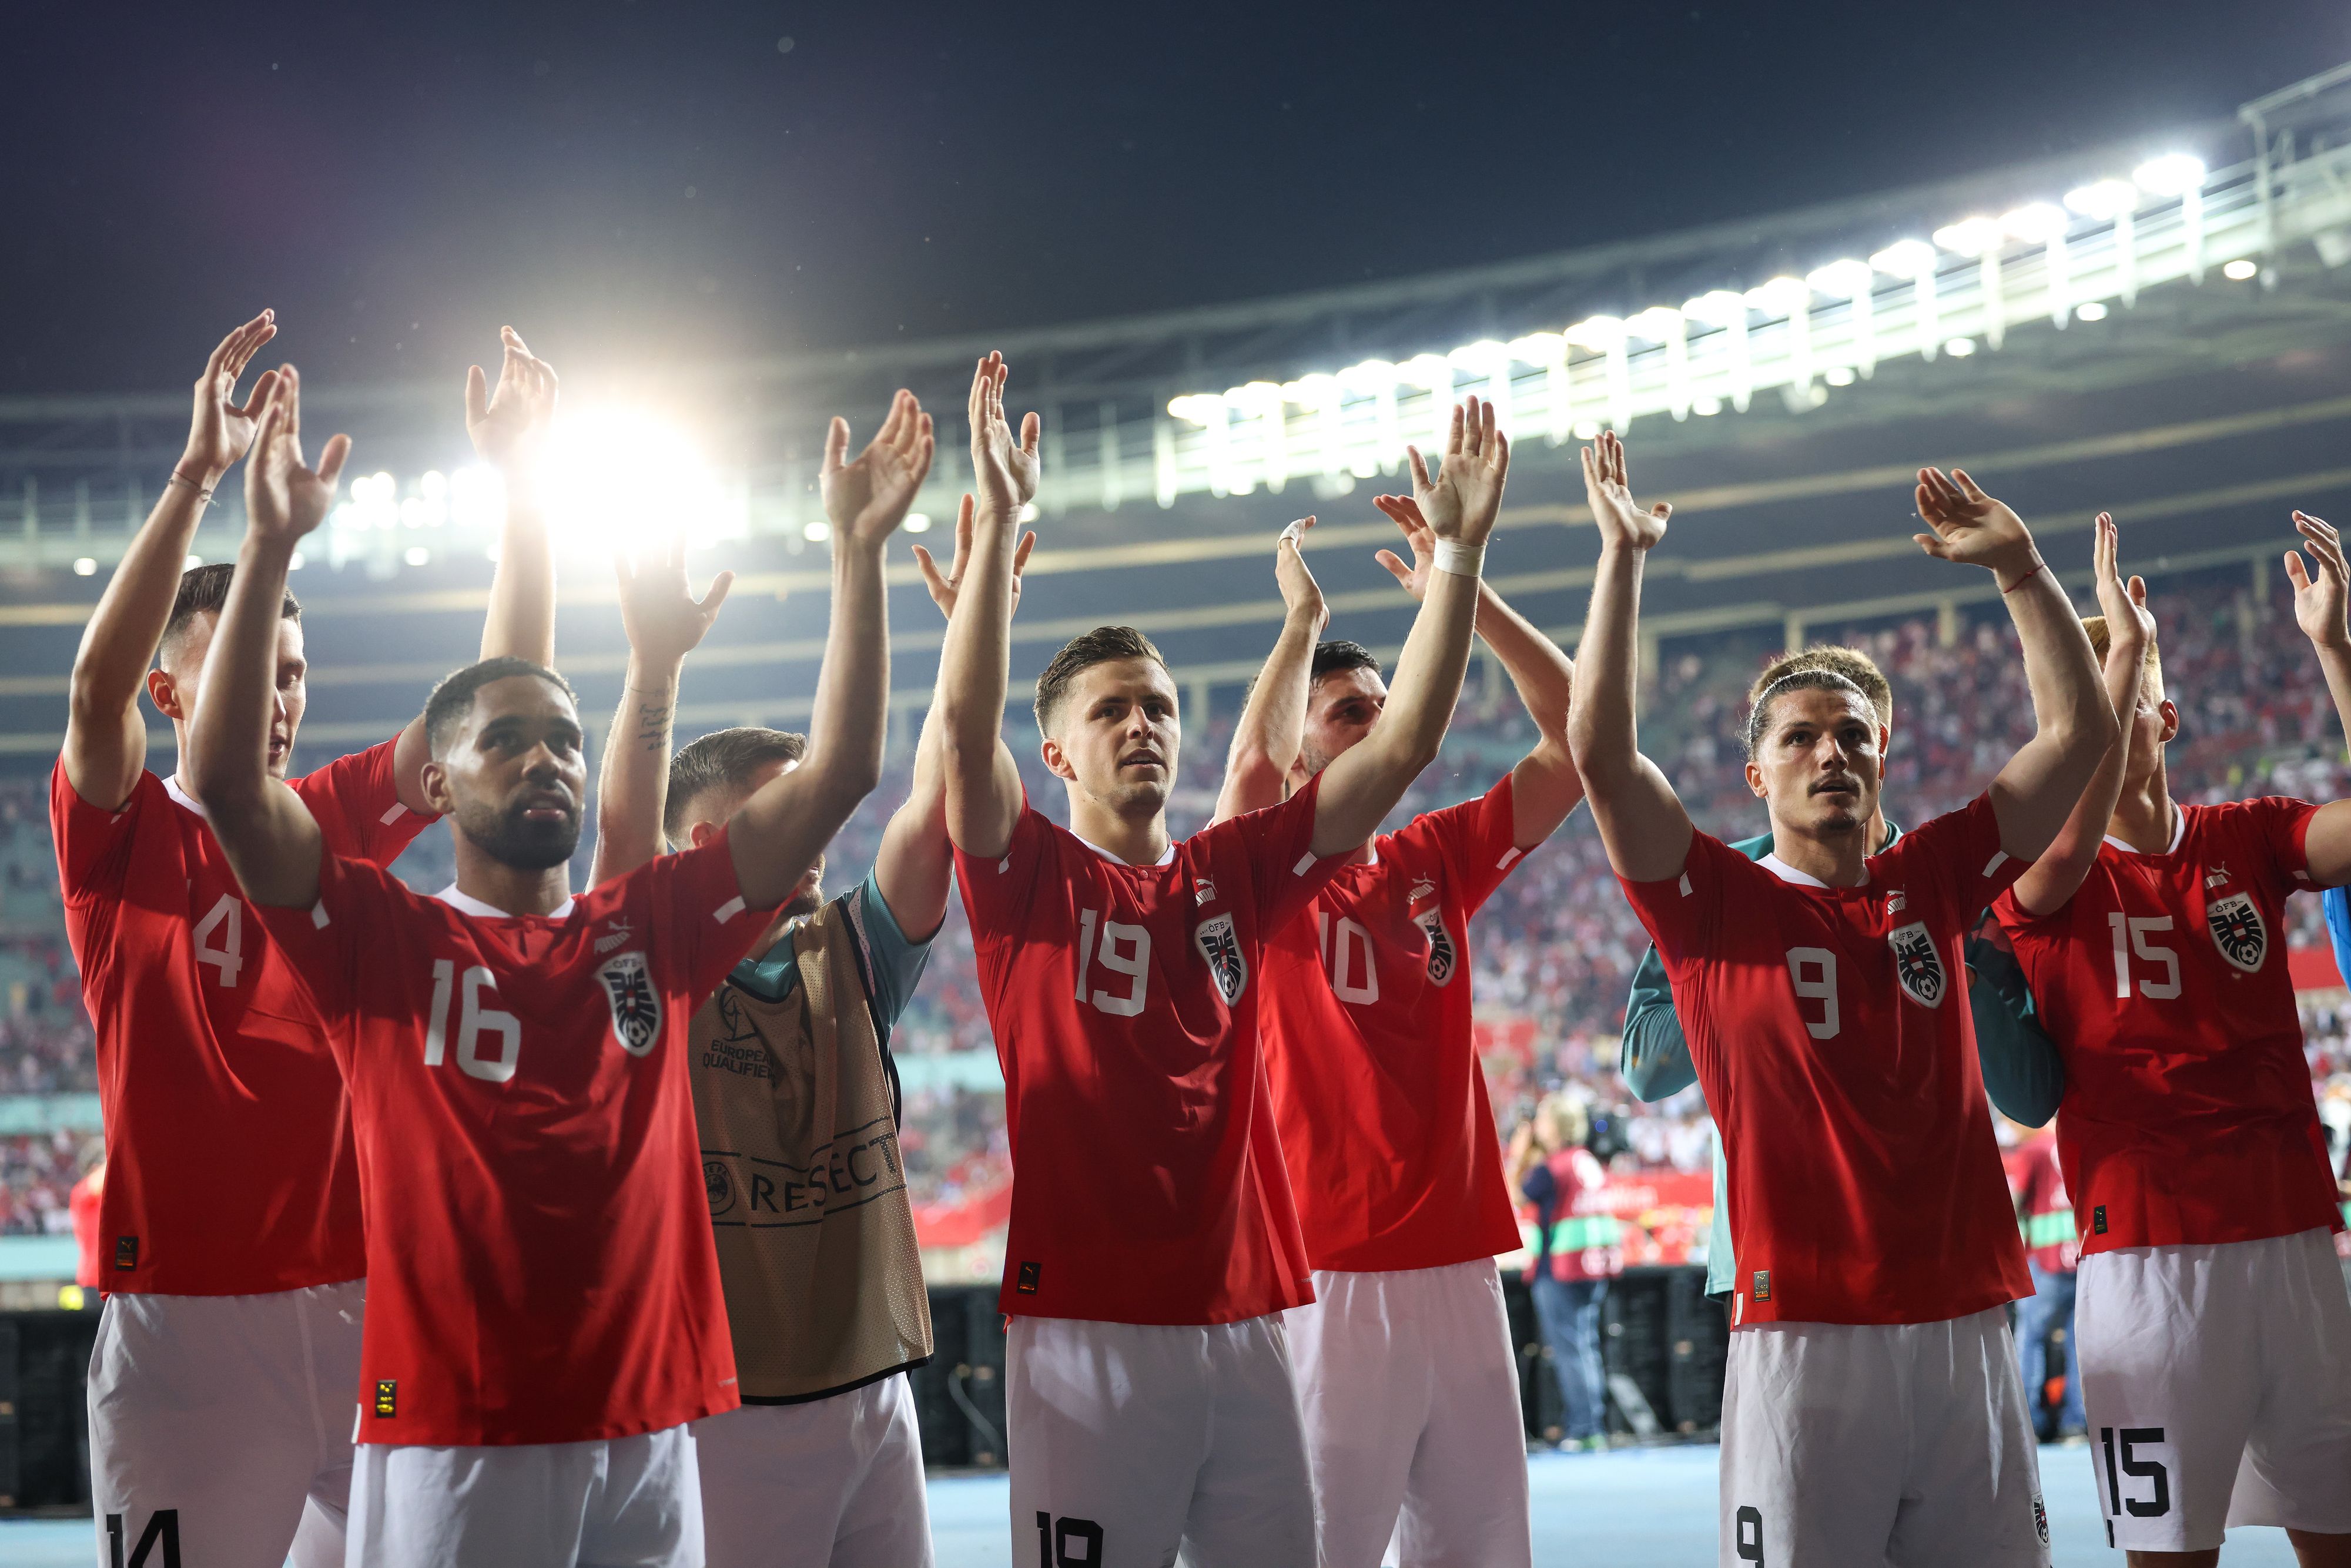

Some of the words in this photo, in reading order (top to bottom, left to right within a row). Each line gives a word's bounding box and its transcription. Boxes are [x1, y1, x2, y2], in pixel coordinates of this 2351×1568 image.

[1195, 887, 1216, 907] UMA
[1208, 922, 1225, 933] ÖFB
[1887, 897, 1905, 915] UMA
[1075, 908, 1151, 1017] 19
[2108, 912, 2182, 1000] 15
[424, 959, 521, 1083] 16
[1786, 947, 1840, 1039] 9
[751, 1131, 896, 1213] RESECT
[2101, 1428, 2170, 1517] 15
[106, 1509, 181, 1568] 14
[1036, 1510, 1103, 1568] 19
[1737, 1505, 1764, 1568] 9
